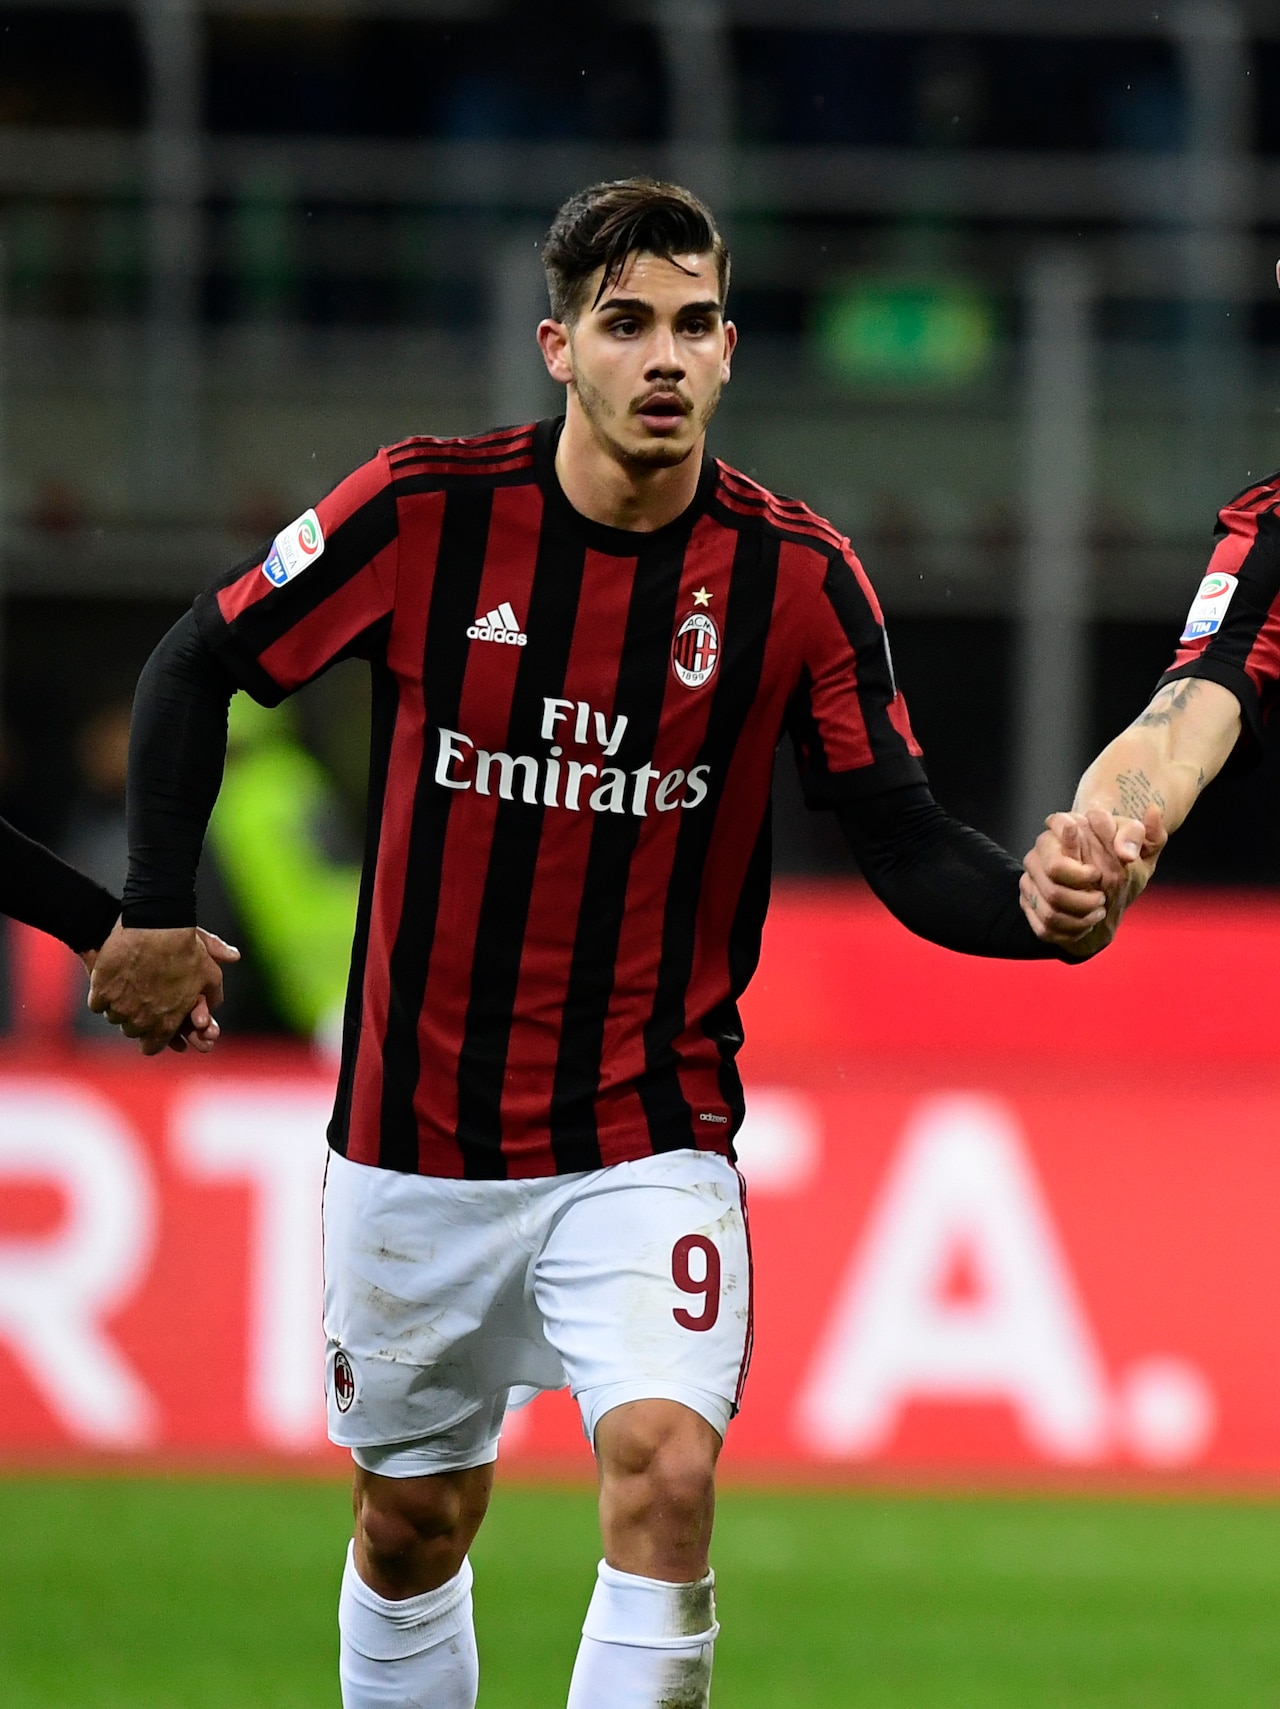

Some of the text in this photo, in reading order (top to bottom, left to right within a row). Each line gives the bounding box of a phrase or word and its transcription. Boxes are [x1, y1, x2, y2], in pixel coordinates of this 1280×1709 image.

[269, 555, 284, 580] TIM
[685, 616, 712, 632] ACM
[1191, 621, 1212, 633] TIM
[466, 625, 528, 647] adidas
[682, 671, 705, 681] 1899
[541, 697, 628, 756] Fly
[435, 727, 711, 817] Emirates
[700, 1113, 727, 1123] adizero
[672, 1234, 721, 1332] 9
